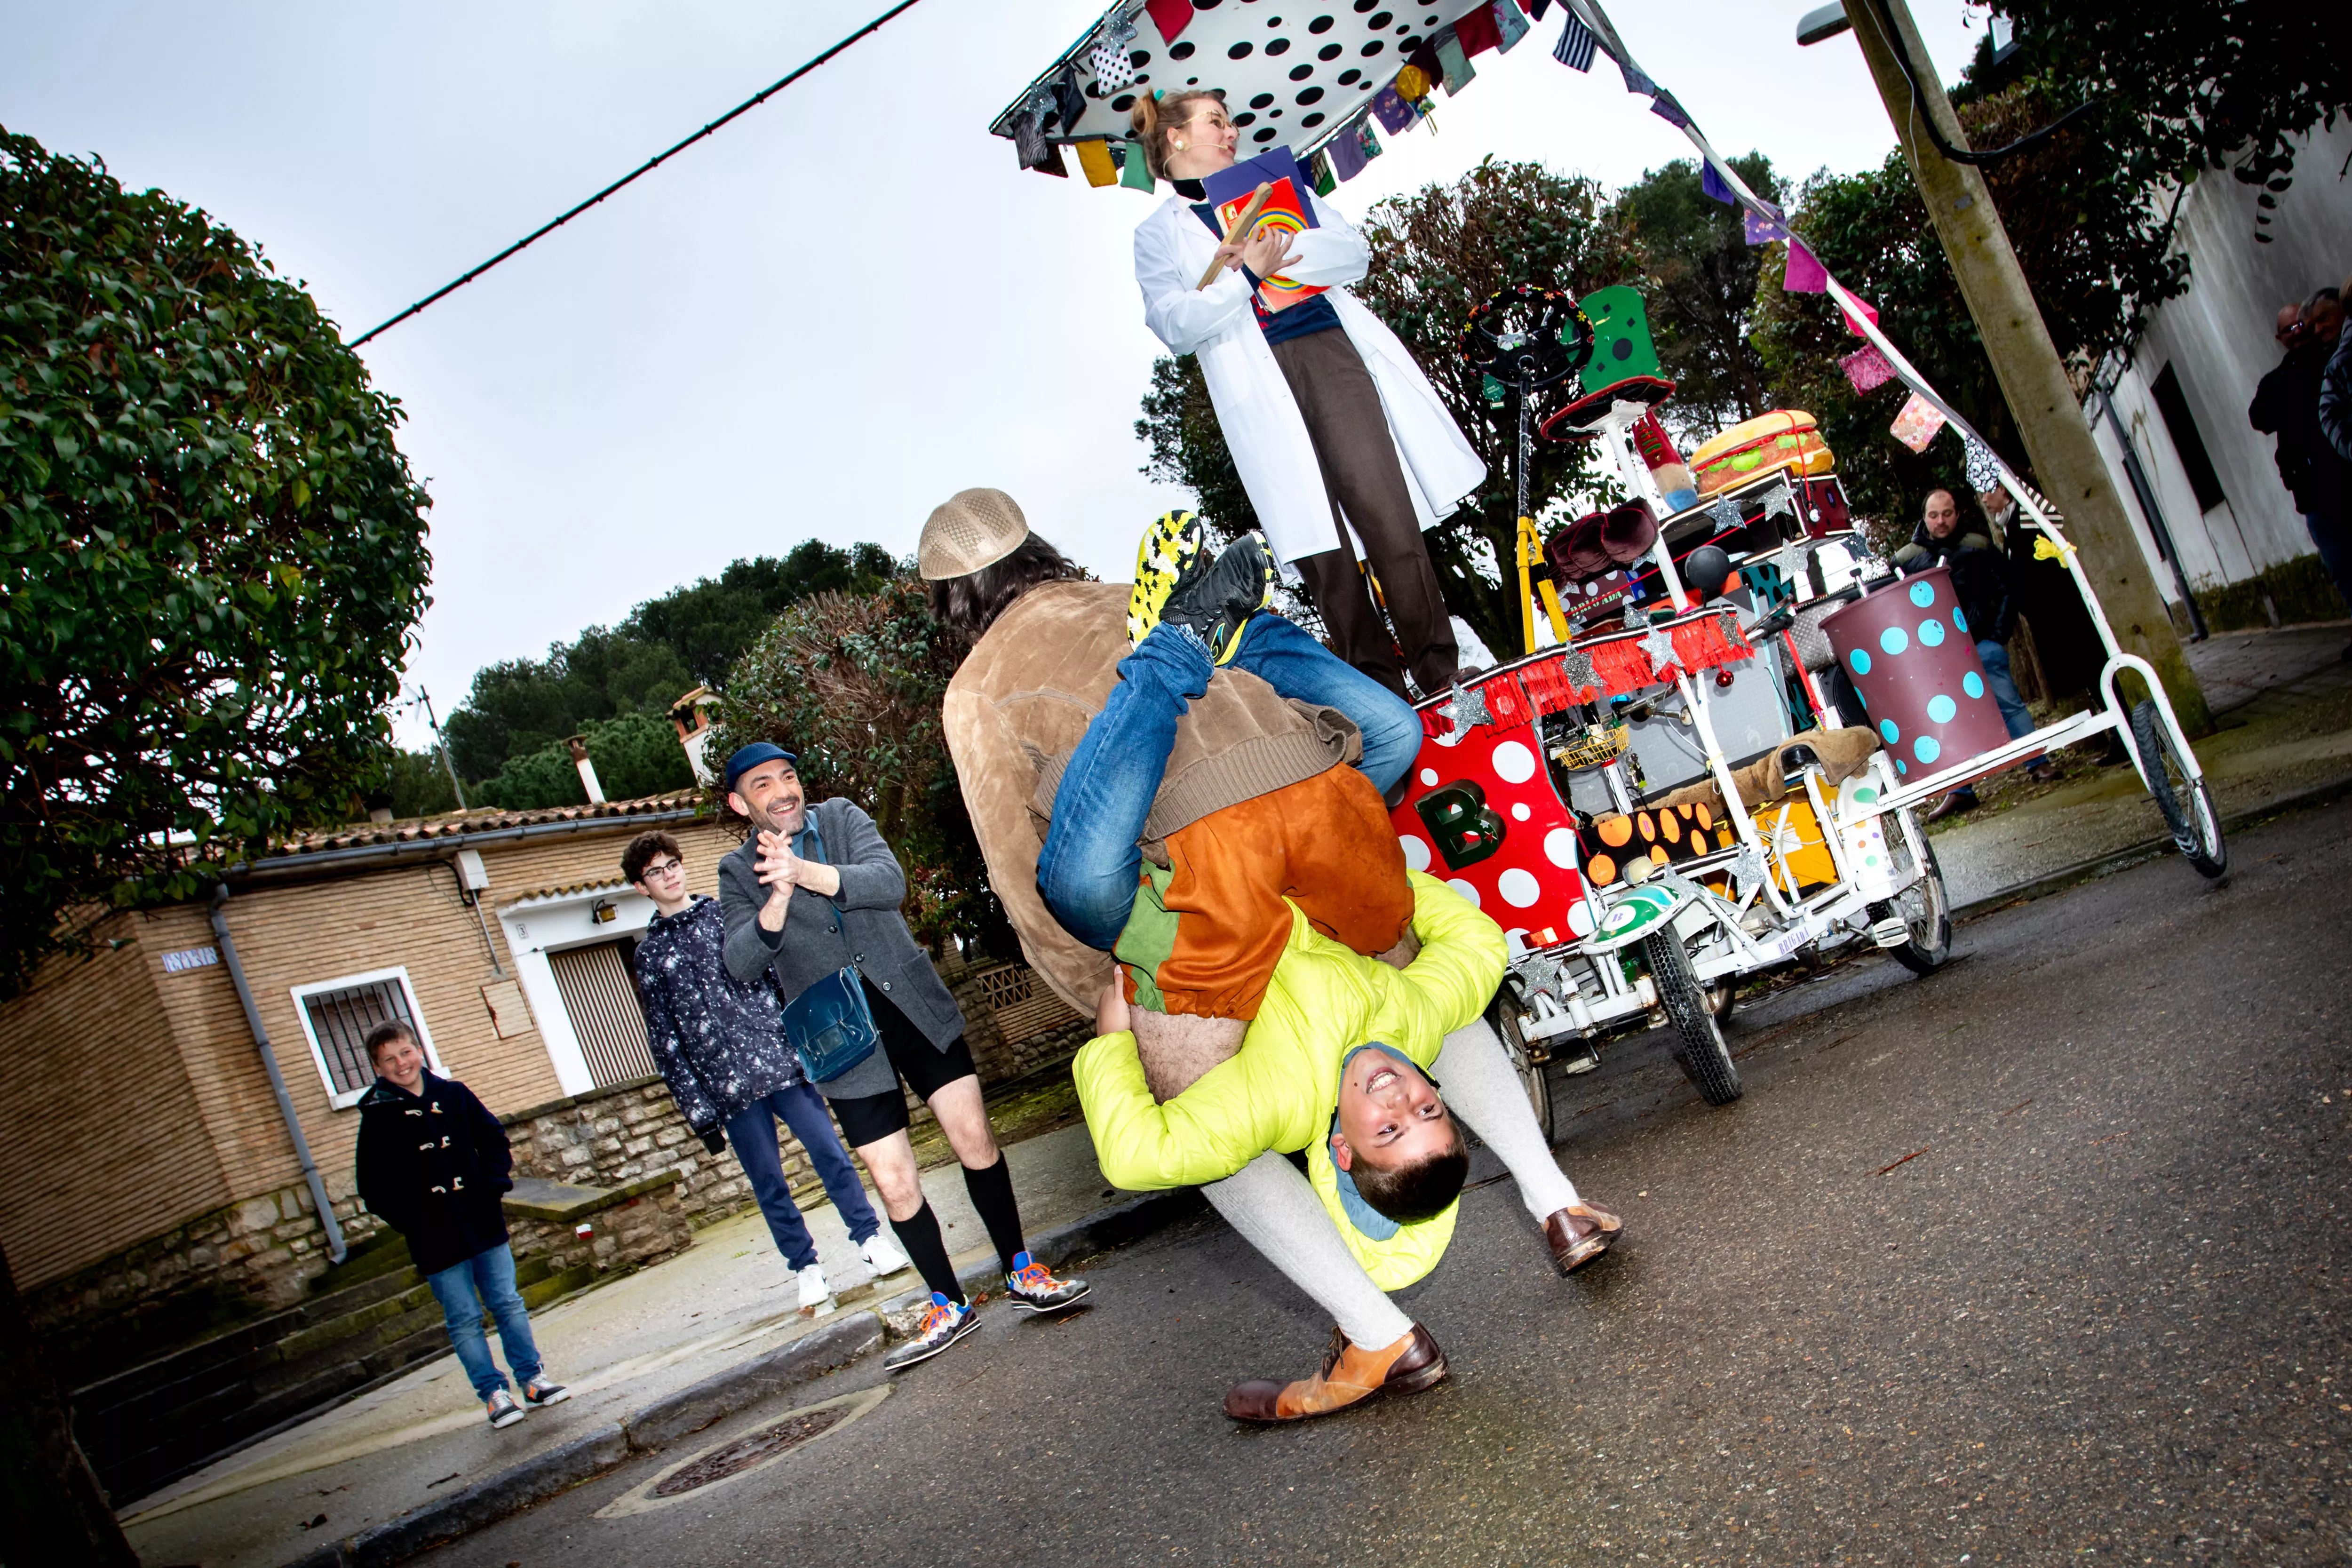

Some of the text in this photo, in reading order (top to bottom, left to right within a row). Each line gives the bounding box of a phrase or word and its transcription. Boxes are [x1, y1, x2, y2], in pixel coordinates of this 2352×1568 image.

[1413, 779, 1507, 872] B
[1612, 913, 1623, 923] B
[1778, 926, 1810, 955] BRIGADA
